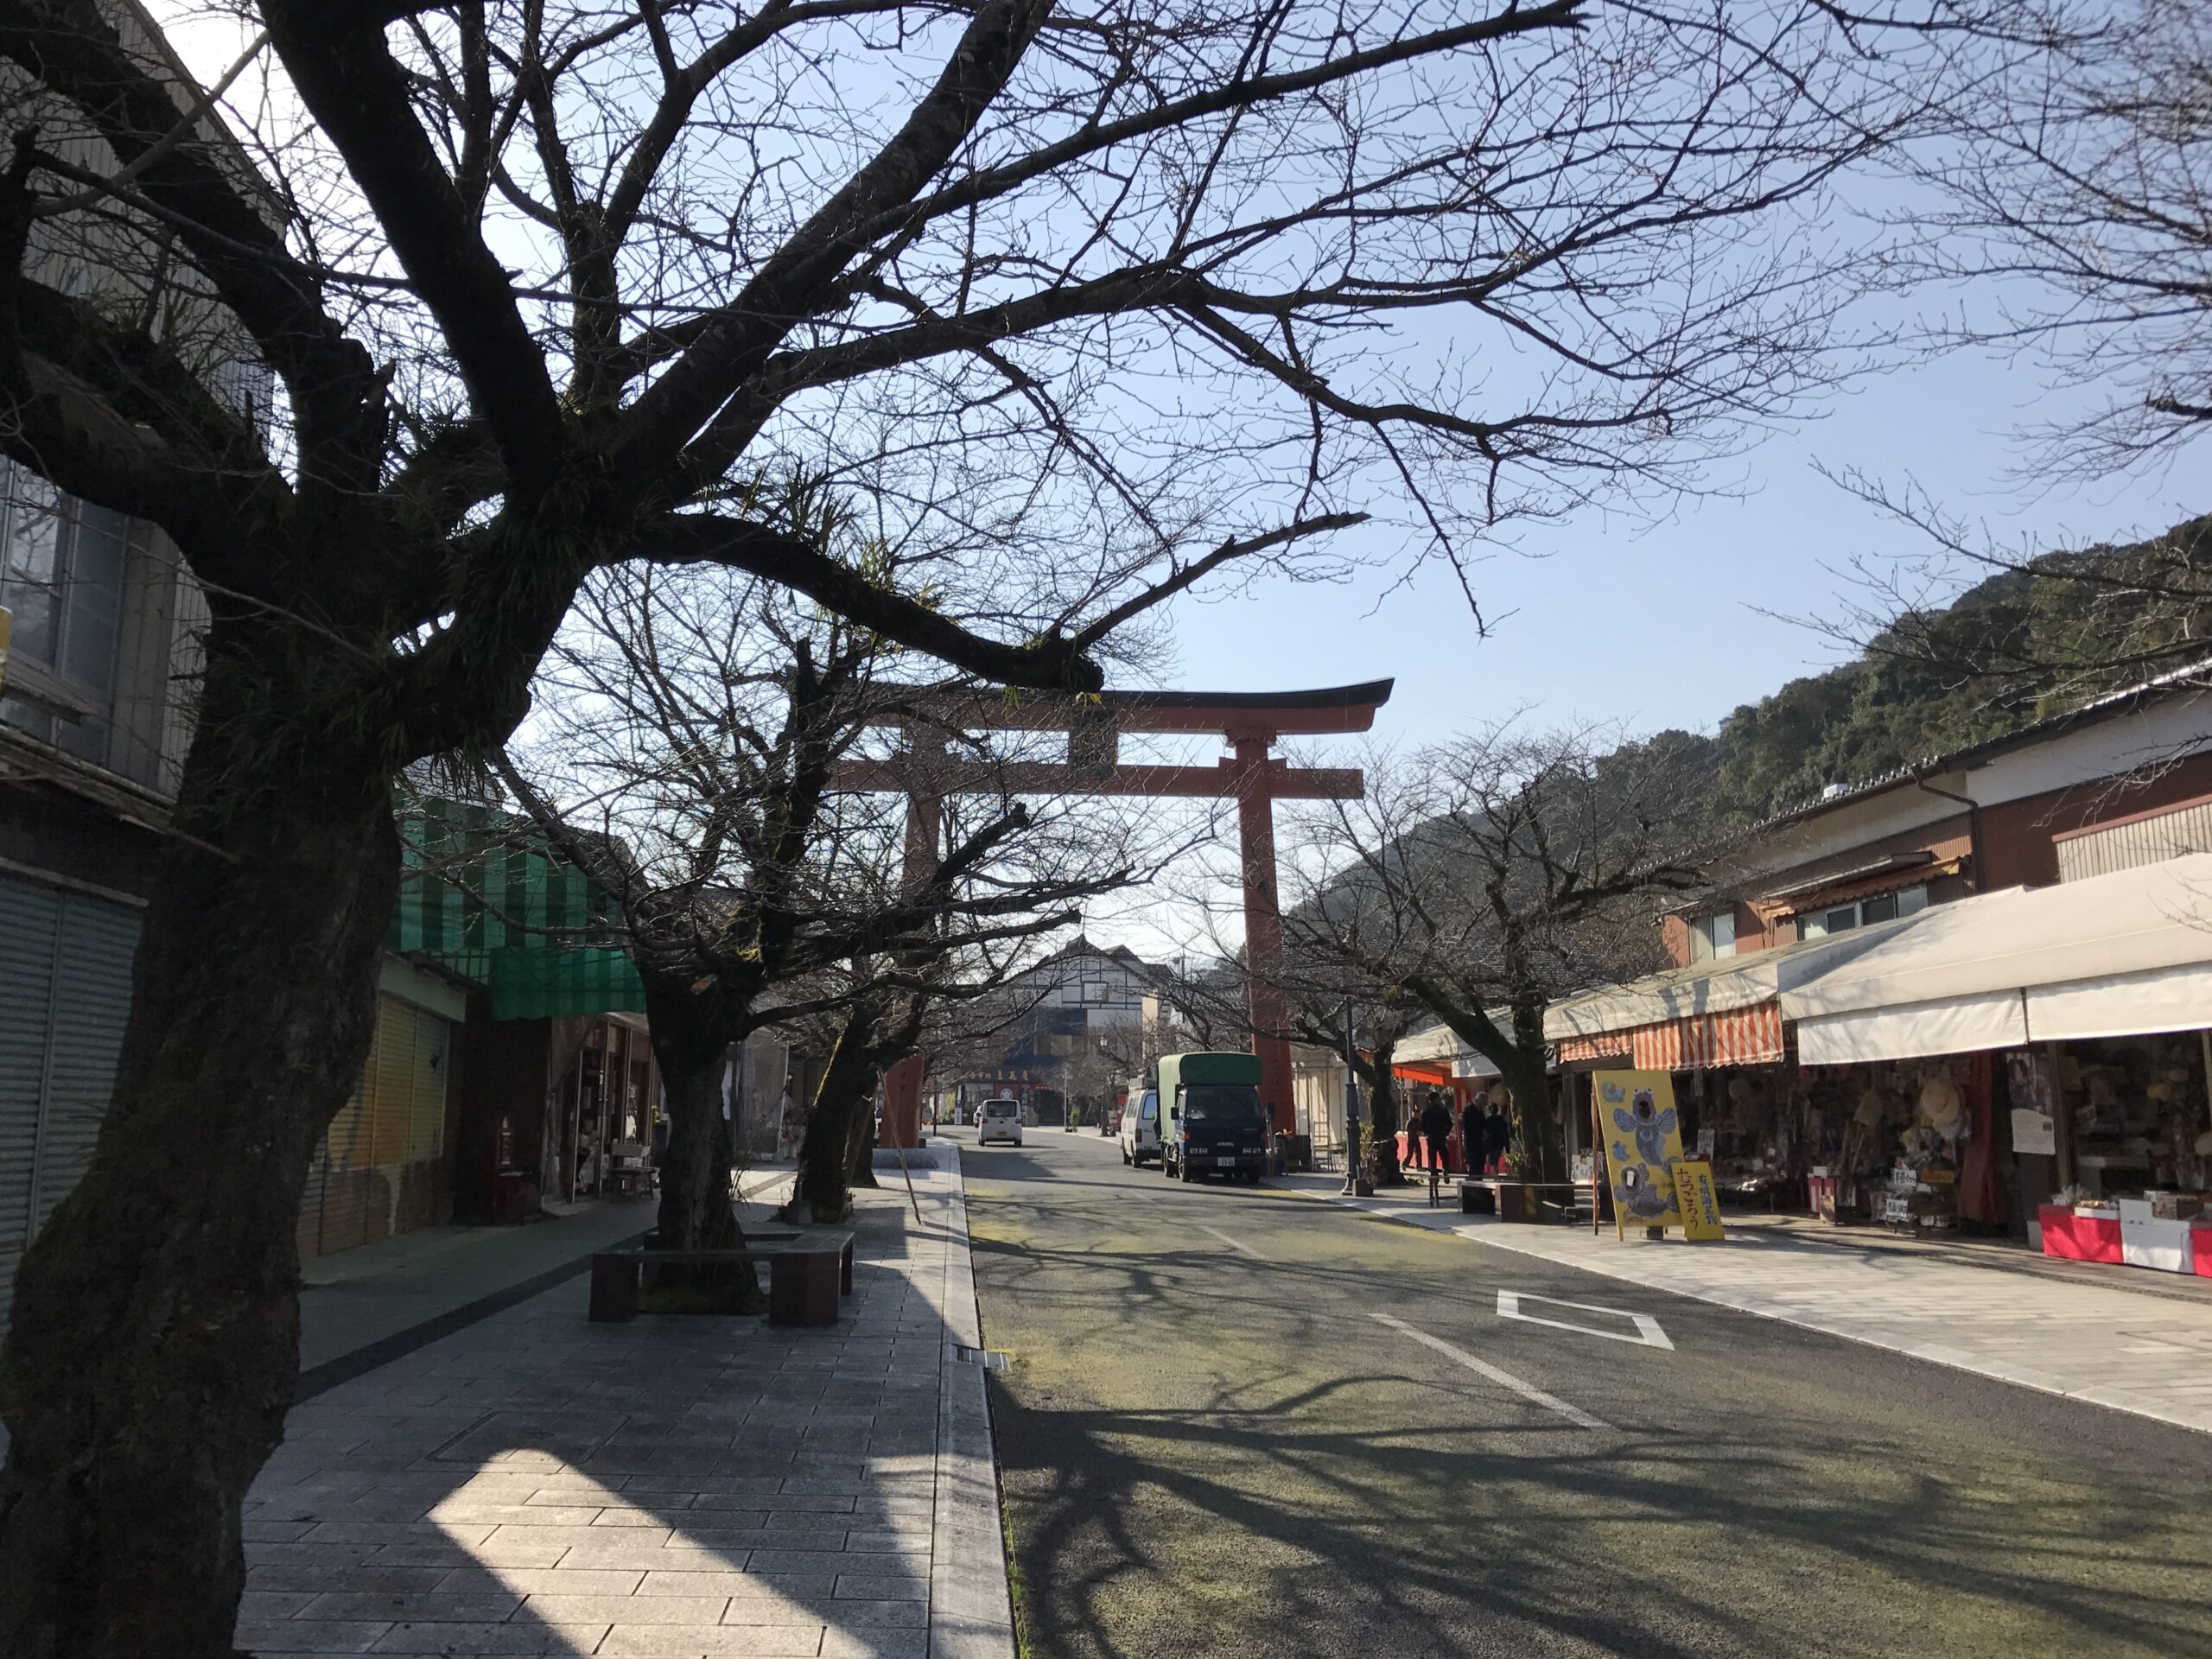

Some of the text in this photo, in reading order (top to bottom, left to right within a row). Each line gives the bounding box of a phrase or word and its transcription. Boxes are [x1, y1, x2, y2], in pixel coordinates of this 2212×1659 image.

[1676, 1167, 1699, 1230] むつごろう
[1698, 1173, 1718, 1225] 有明海名物
